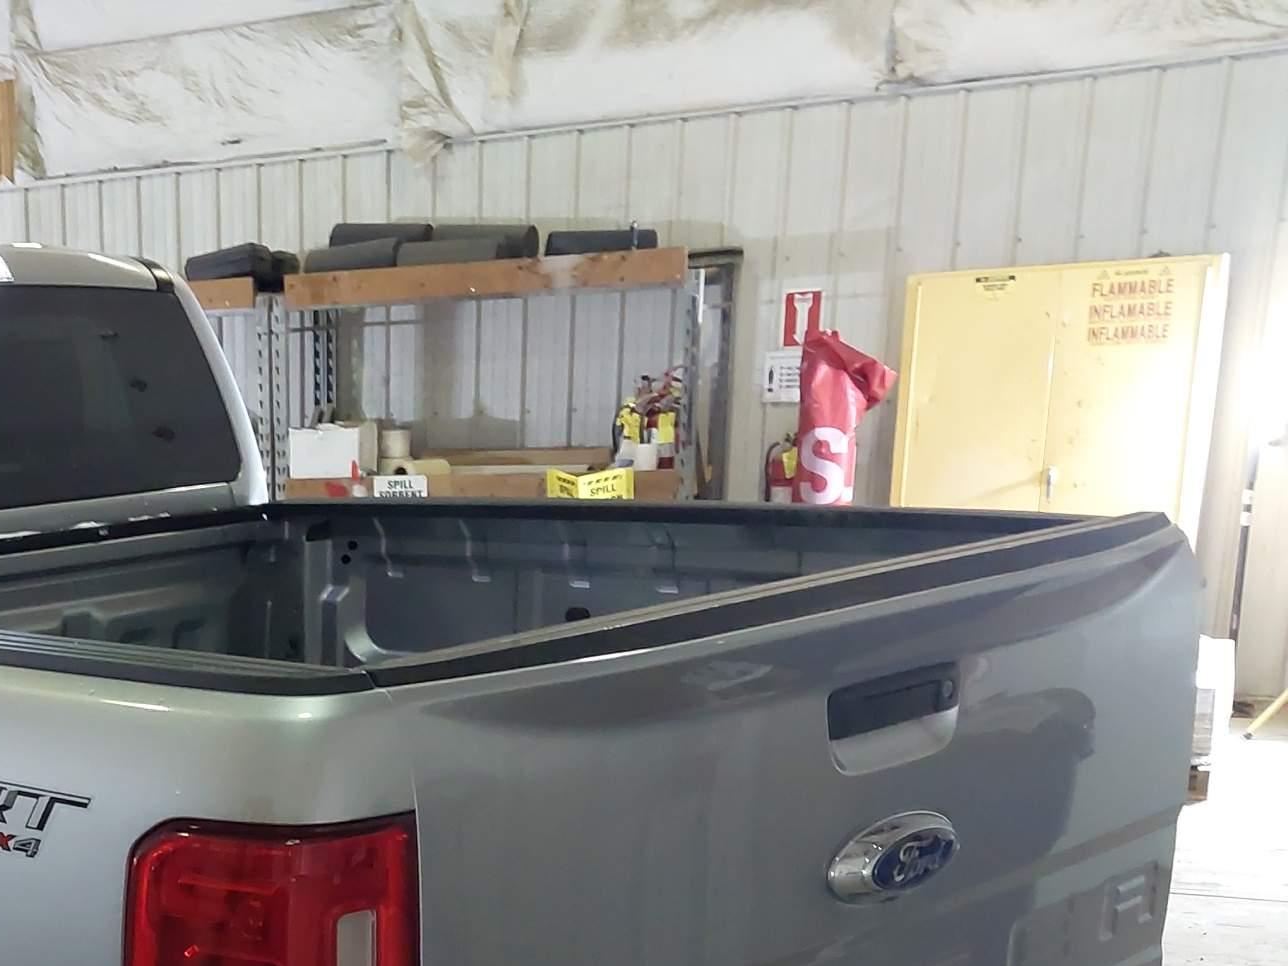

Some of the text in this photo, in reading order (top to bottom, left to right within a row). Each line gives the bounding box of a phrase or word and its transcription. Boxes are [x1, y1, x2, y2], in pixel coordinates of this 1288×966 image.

[1092, 278, 1174, 297] FLAMMABLE
[1089, 301, 1172, 322] INFLAMABLE
[1088, 323, 1169, 343] INFLAMMABLE
[387, 480, 413, 489] SPILL
[590, 483, 616, 496] SPILL
[893, 838, 950, 884] Ford
